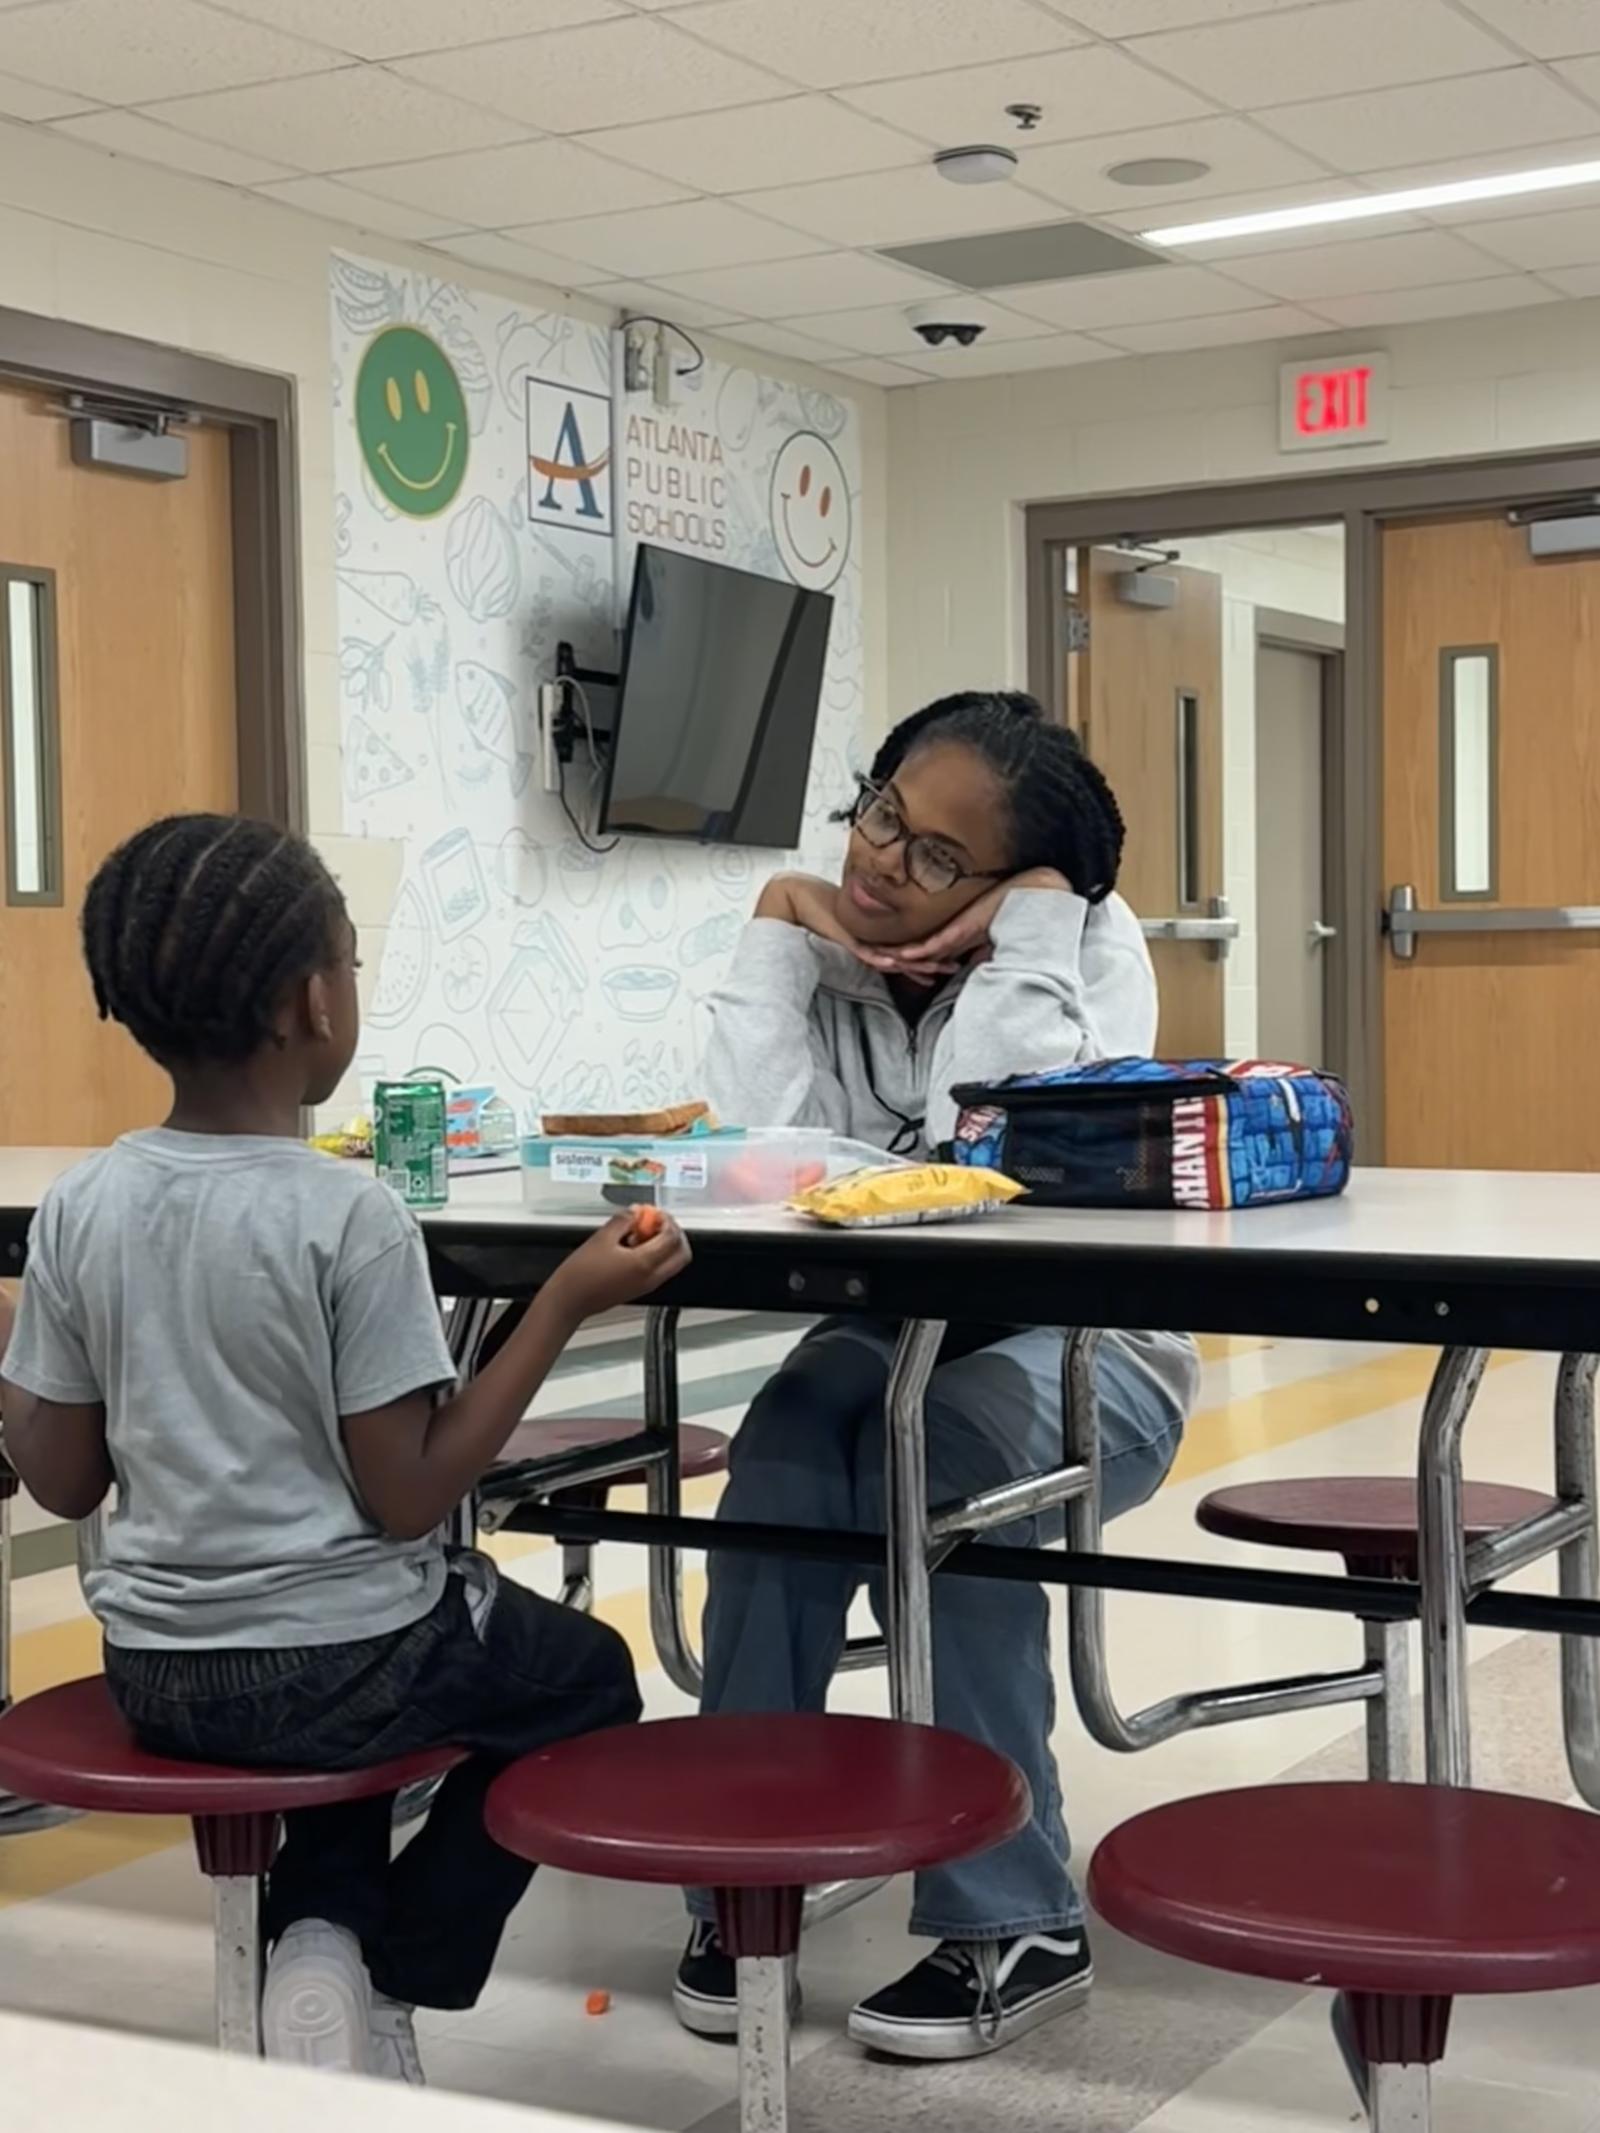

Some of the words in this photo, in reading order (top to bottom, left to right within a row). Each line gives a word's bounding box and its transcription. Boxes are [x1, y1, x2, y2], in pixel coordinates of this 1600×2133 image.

[1295, 366, 1371, 434] EXIT
[538, 401, 604, 519] A
[626, 414, 725, 467] ATLANTA
[627, 456, 725, 509] PUBLIC
[626, 500, 727, 551] SCHOOLS
[555, 1153, 603, 1167] sistema
